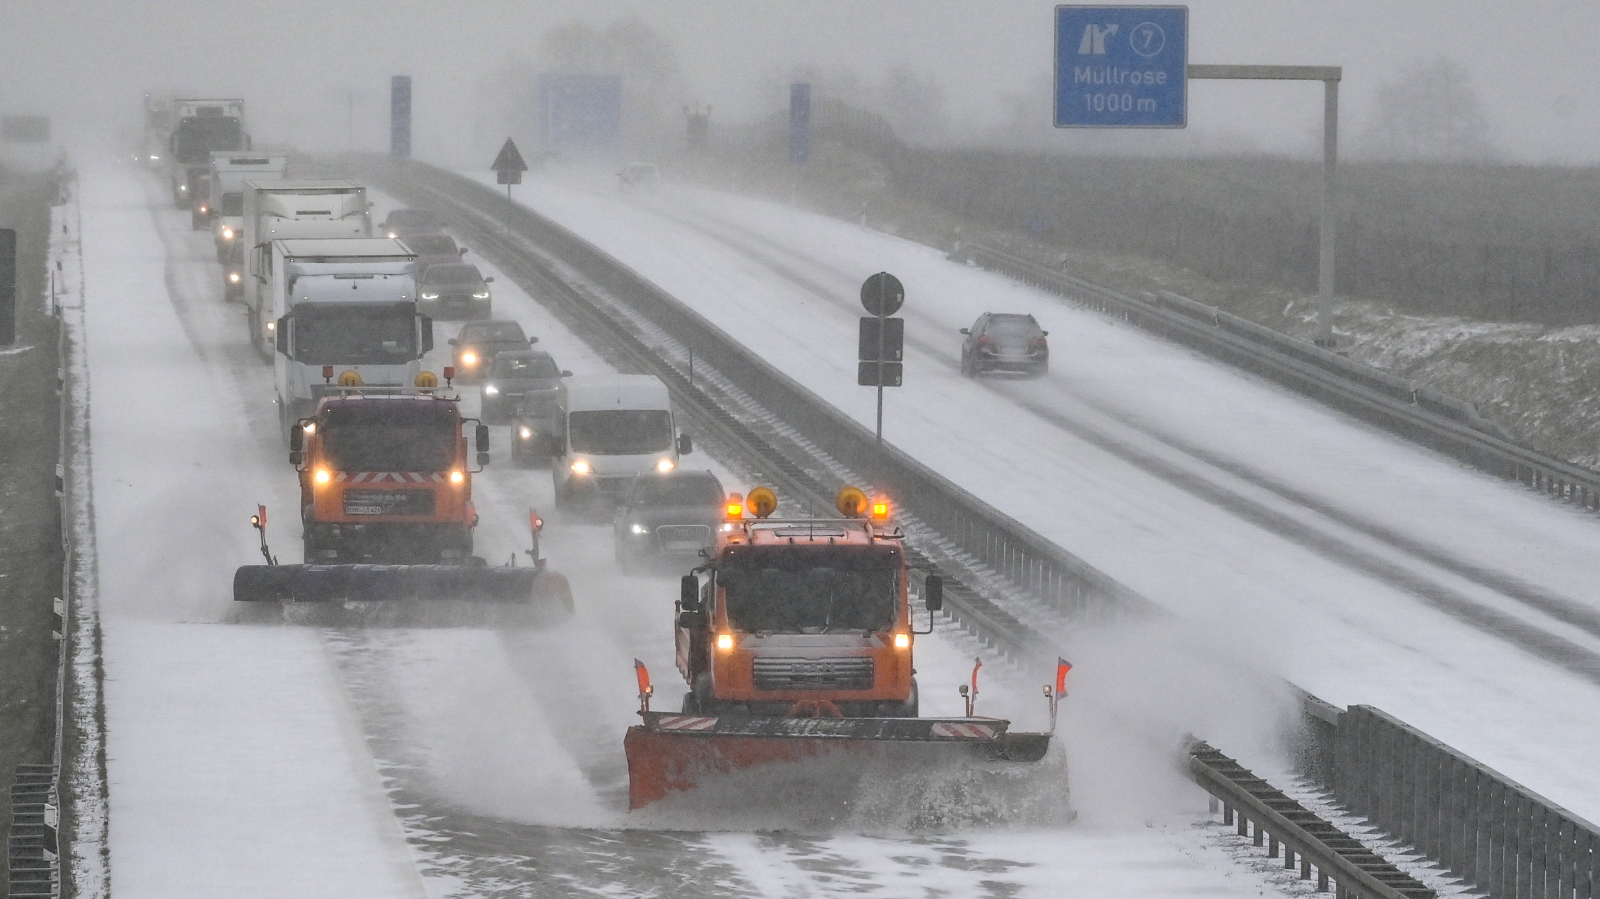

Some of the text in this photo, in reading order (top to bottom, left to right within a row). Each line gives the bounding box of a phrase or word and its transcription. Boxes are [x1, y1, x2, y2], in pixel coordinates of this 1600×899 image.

[1142, 30, 1154, 48] 7
[1074, 66, 1167, 84] Müllrose
[1085, 93, 1155, 111] 1000 m
[791, 663, 836, 673] MAN
